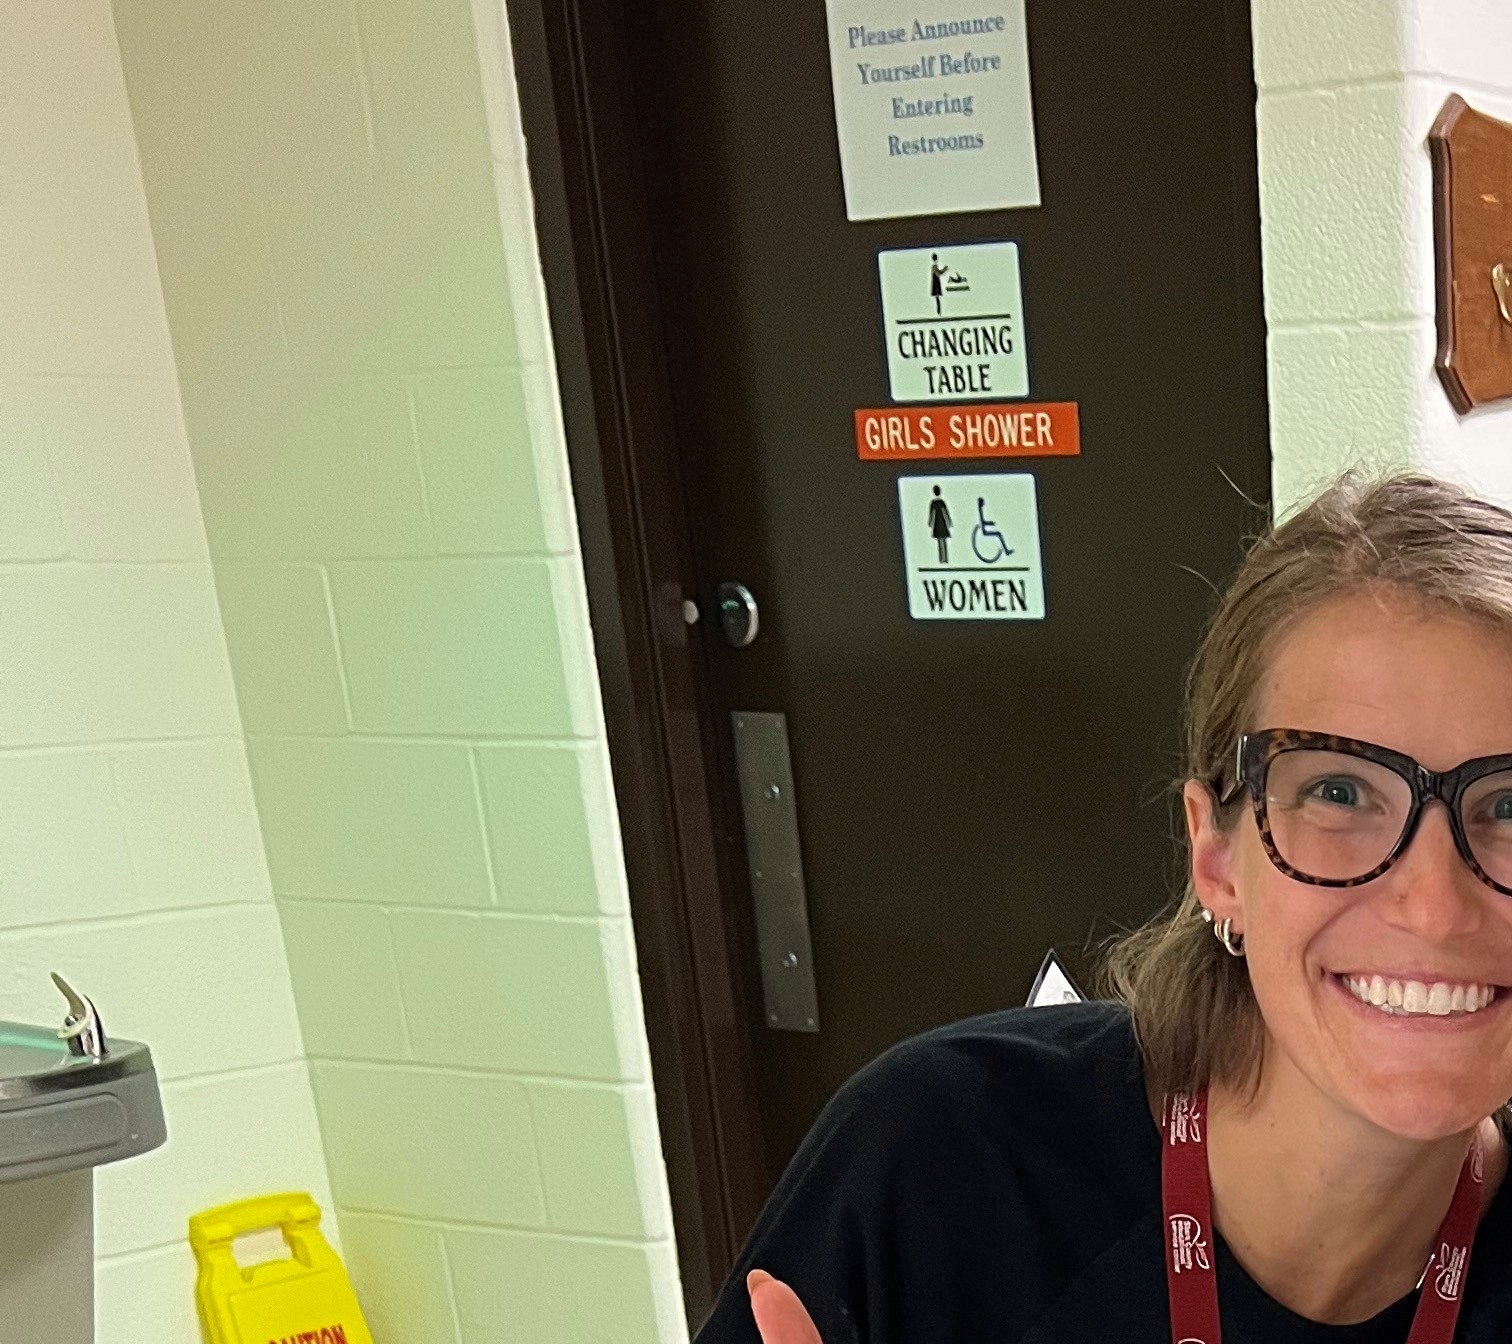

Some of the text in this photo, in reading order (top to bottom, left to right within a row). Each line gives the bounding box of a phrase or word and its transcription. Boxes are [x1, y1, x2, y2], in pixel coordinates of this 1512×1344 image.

[848, 16, 1005, 49] Please Announce
[857, 51, 1001, 85] Yourself Before
[892, 91, 974, 120] Entering
[888, 132, 985, 157] Restrooms
[897, 324, 1013, 360] CHANGING
[922, 363, 992, 395] TABLE
[864, 411, 1054, 452] GIRLS SHOWER
[922, 578, 1028, 614] WOMEN
